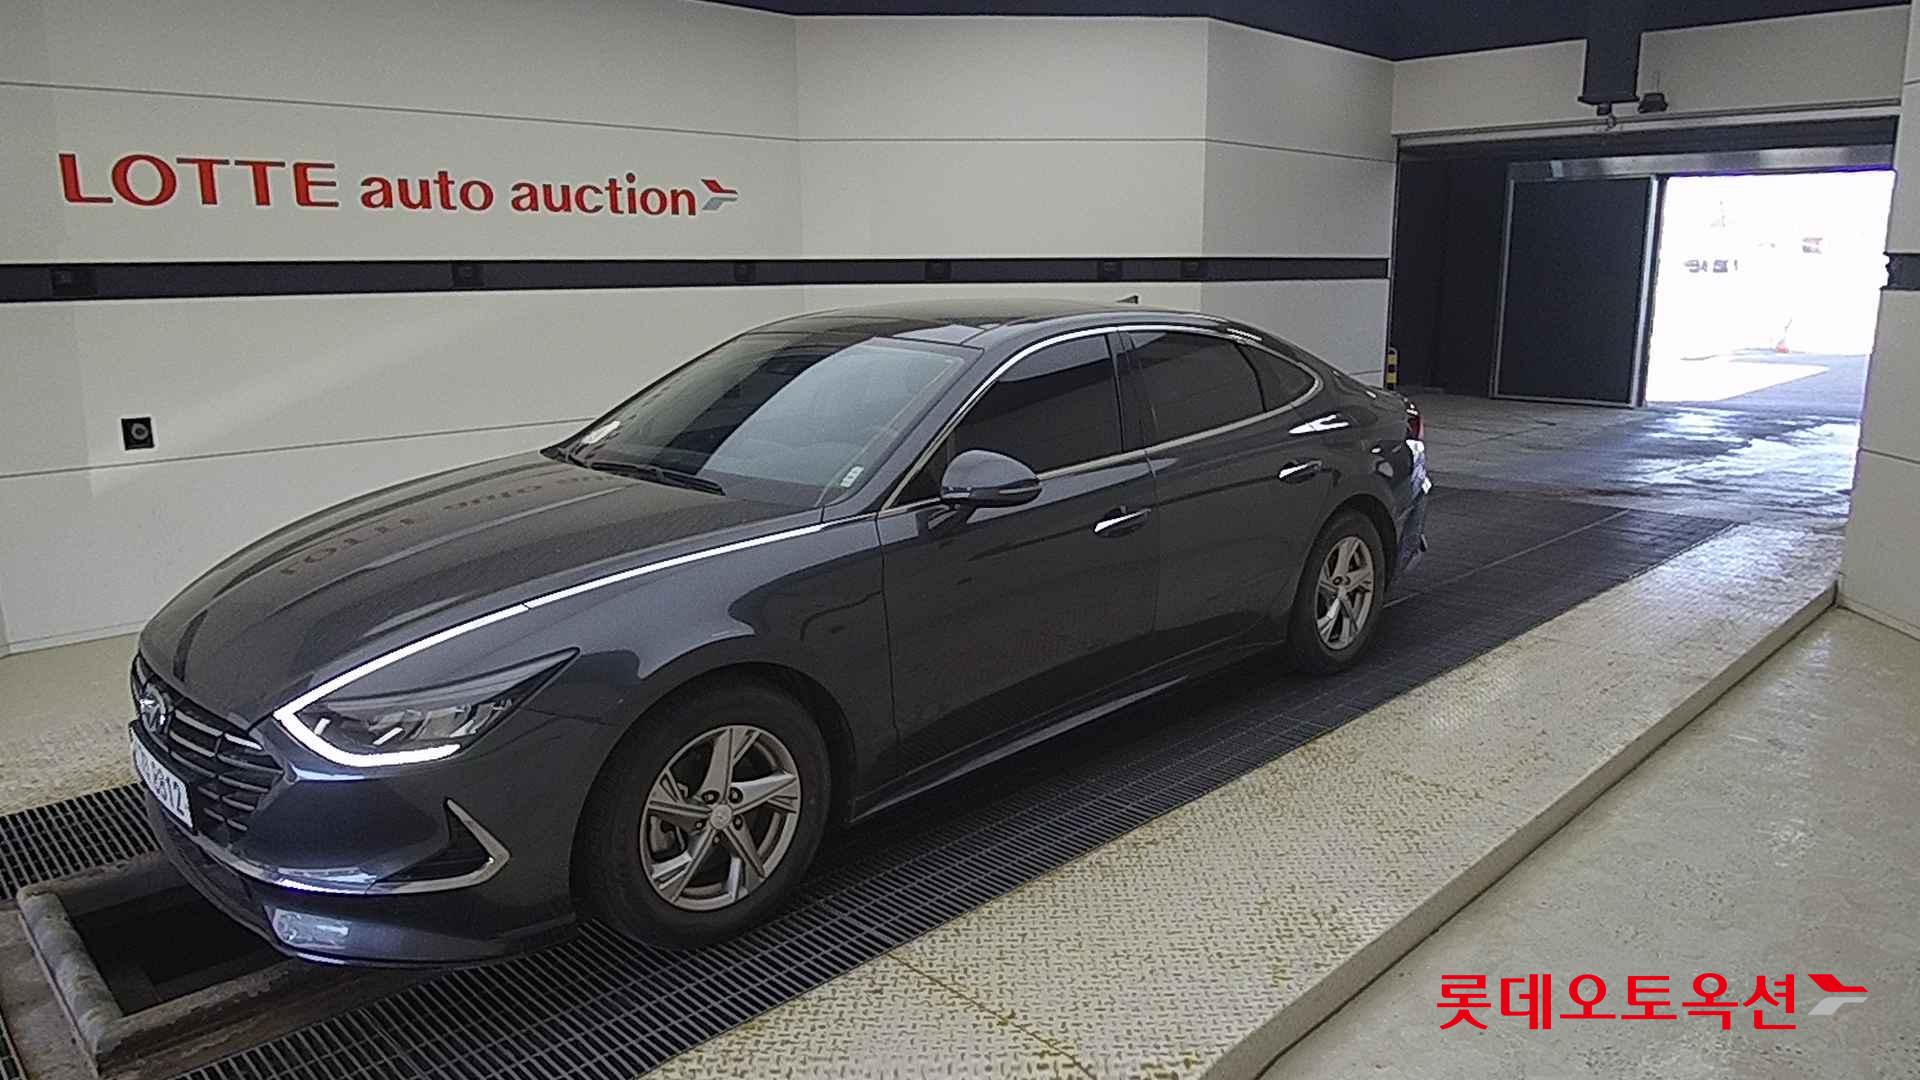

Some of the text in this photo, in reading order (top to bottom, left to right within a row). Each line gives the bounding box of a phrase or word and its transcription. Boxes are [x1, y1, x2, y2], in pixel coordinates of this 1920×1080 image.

[59, 153, 698, 216] LOTTE auto auction
